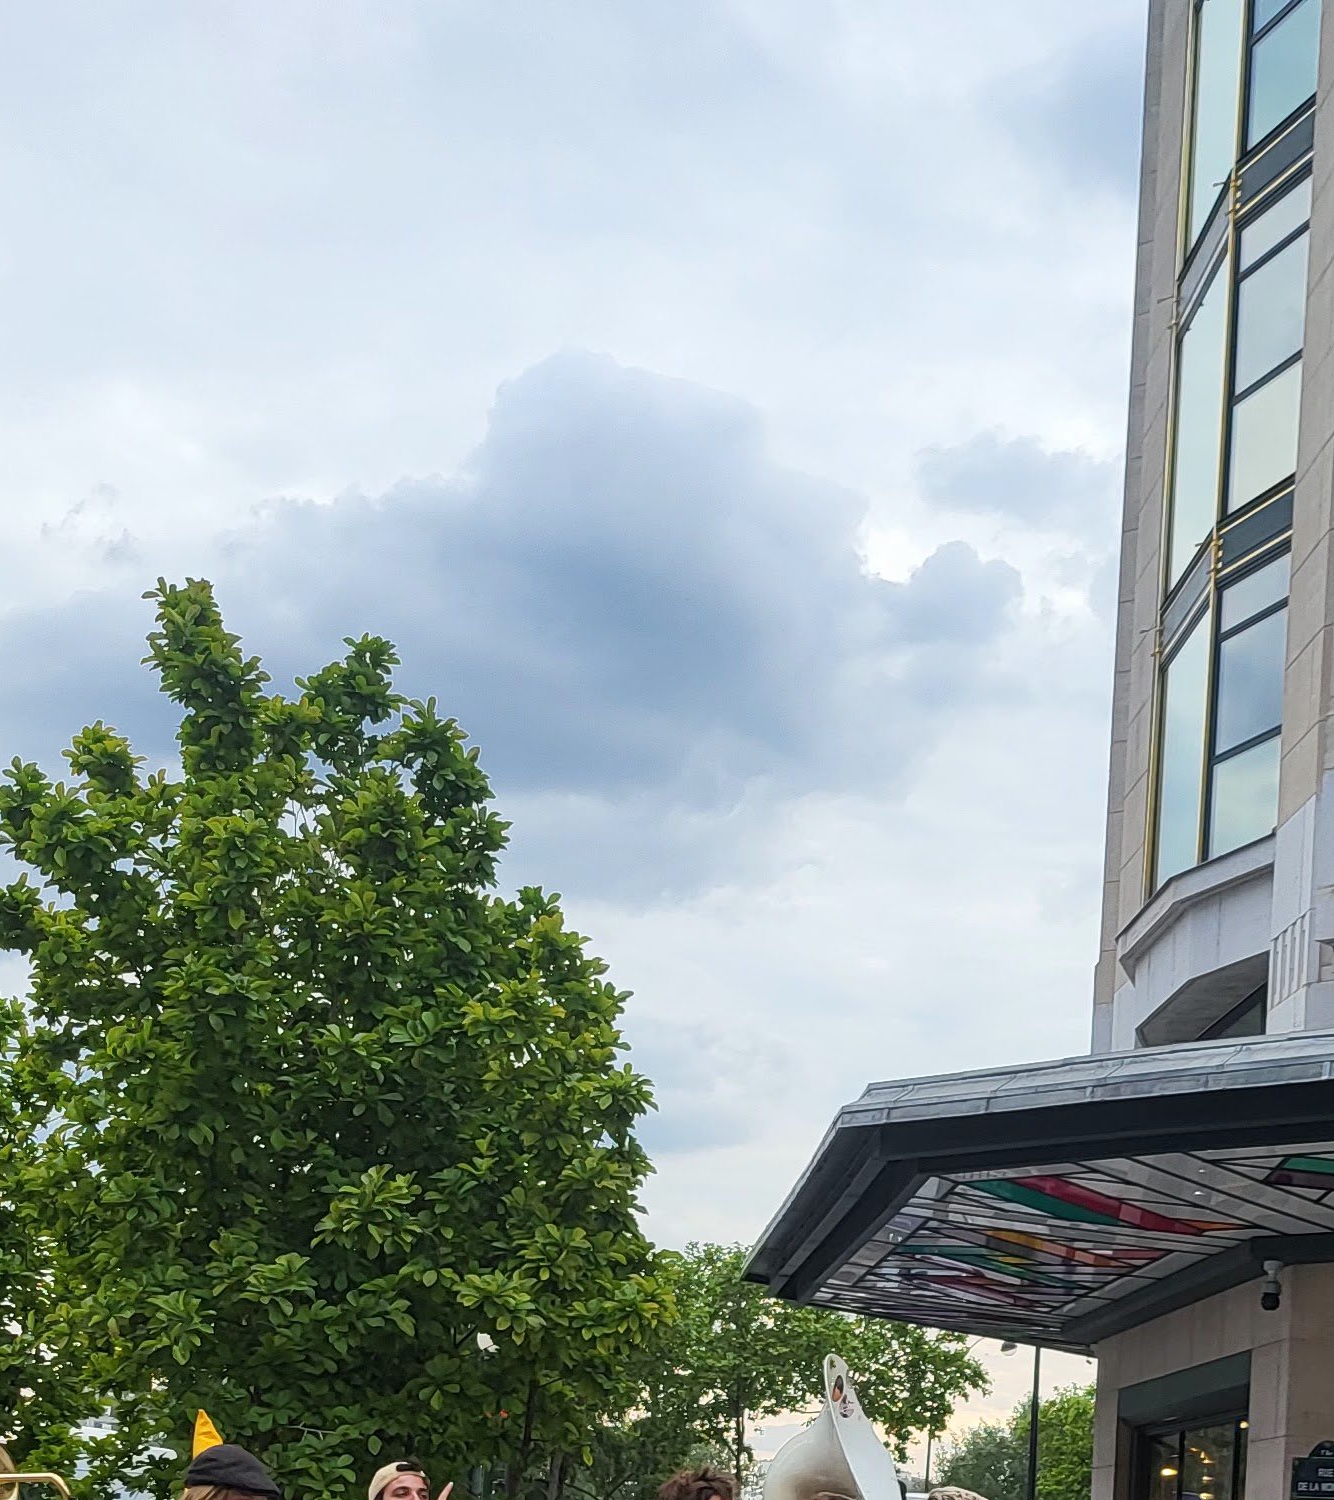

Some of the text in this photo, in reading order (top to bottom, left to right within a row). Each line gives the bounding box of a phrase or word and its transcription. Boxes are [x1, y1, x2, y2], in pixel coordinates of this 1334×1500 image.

[1317, 1468, 1334, 1477] RUE
[1297, 1482, 1308, 1491] DE
[1309, 1482, 1319, 1491] LA
